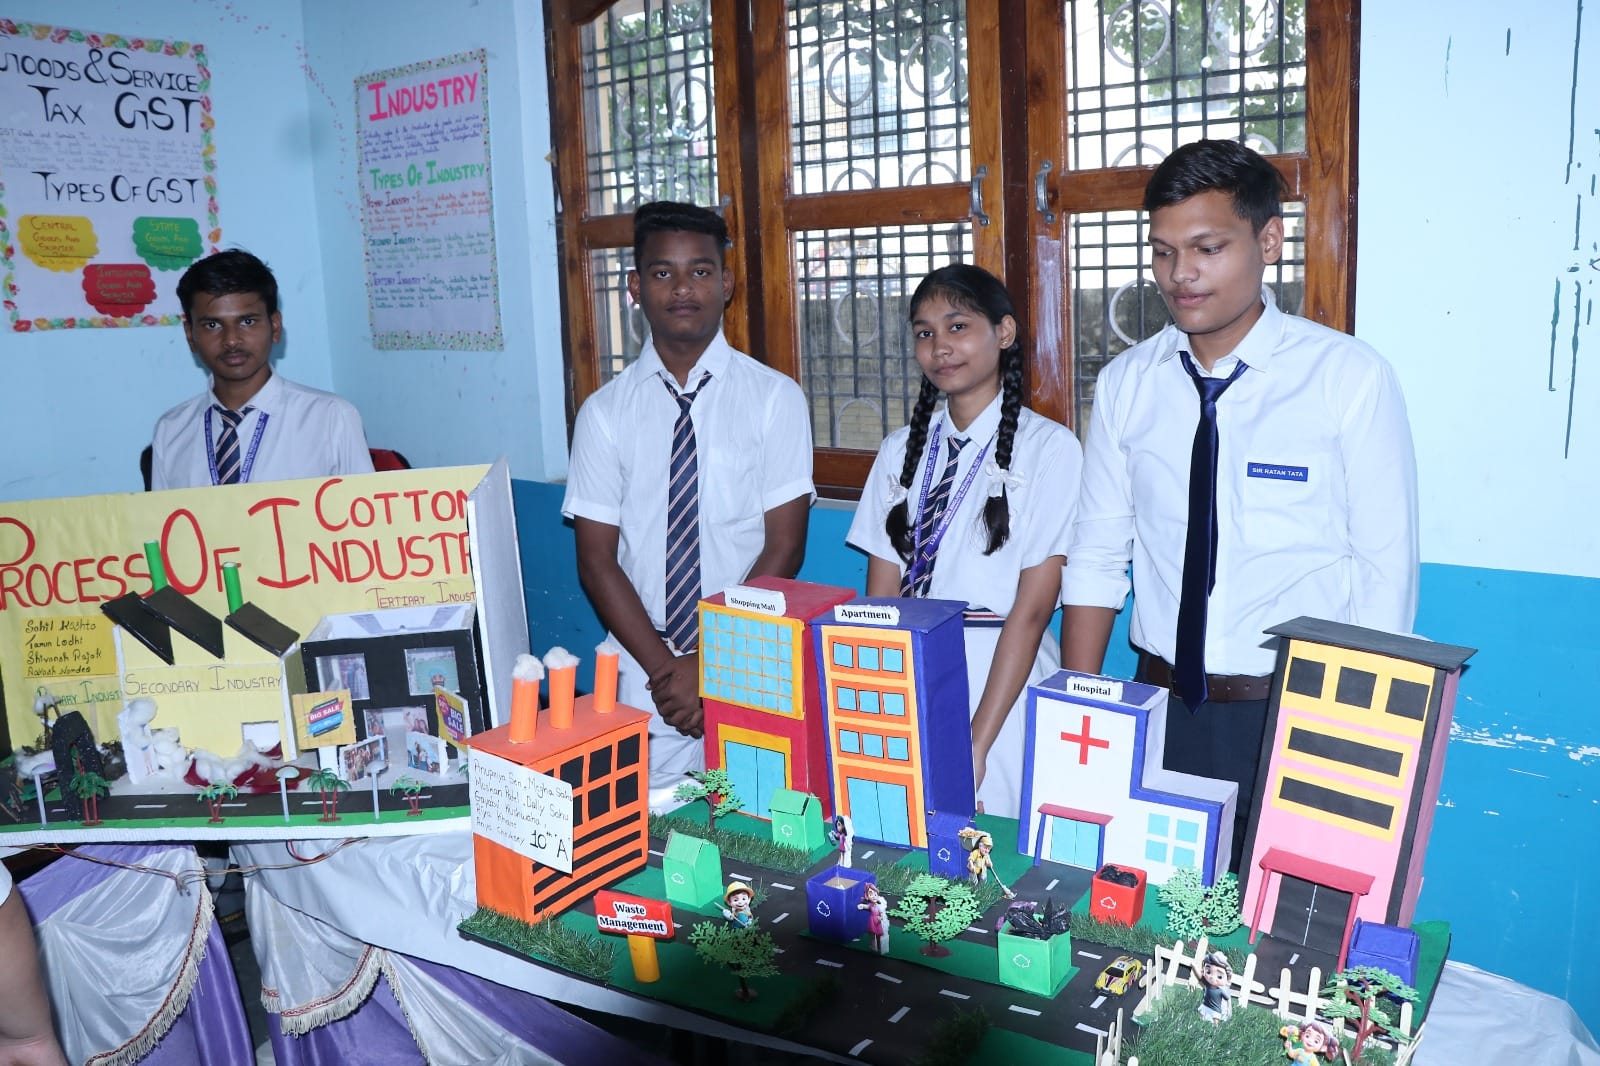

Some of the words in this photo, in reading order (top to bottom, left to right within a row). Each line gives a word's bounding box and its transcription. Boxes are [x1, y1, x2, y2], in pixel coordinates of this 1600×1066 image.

[83, 48, 109, 87] &
[108, 51, 200, 92] SERVICE
[367, 72, 478, 121] INDUSTRY
[27, 84, 86, 125] TAX
[114, 92, 200, 133] GST
[369, 168, 404, 190] TYPES
[407, 162, 423, 187] OF
[426, 160, 485, 184] INDUSTRY
[31, 171, 105, 202] TYPES
[111, 174, 142, 202] OF
[147, 176, 201, 204] GST
[365, 587, 425, 608] TERTIARY
[730, 597, 760, 610] Shopping
[761, 603, 776, 611] Mall
[841, 609, 891, 620] Apartment
[125, 673, 200, 695] SECONDARY
[208, 665, 282, 691] INDUSTRY
[1073, 683, 1111, 696] Hospital
[322, 704, 340, 716] SALE
[450, 708, 462, 723] BIG
[447, 716, 464, 734] SALE
[614, 903, 645, 914] Waste
[599, 916, 665, 931] Management
